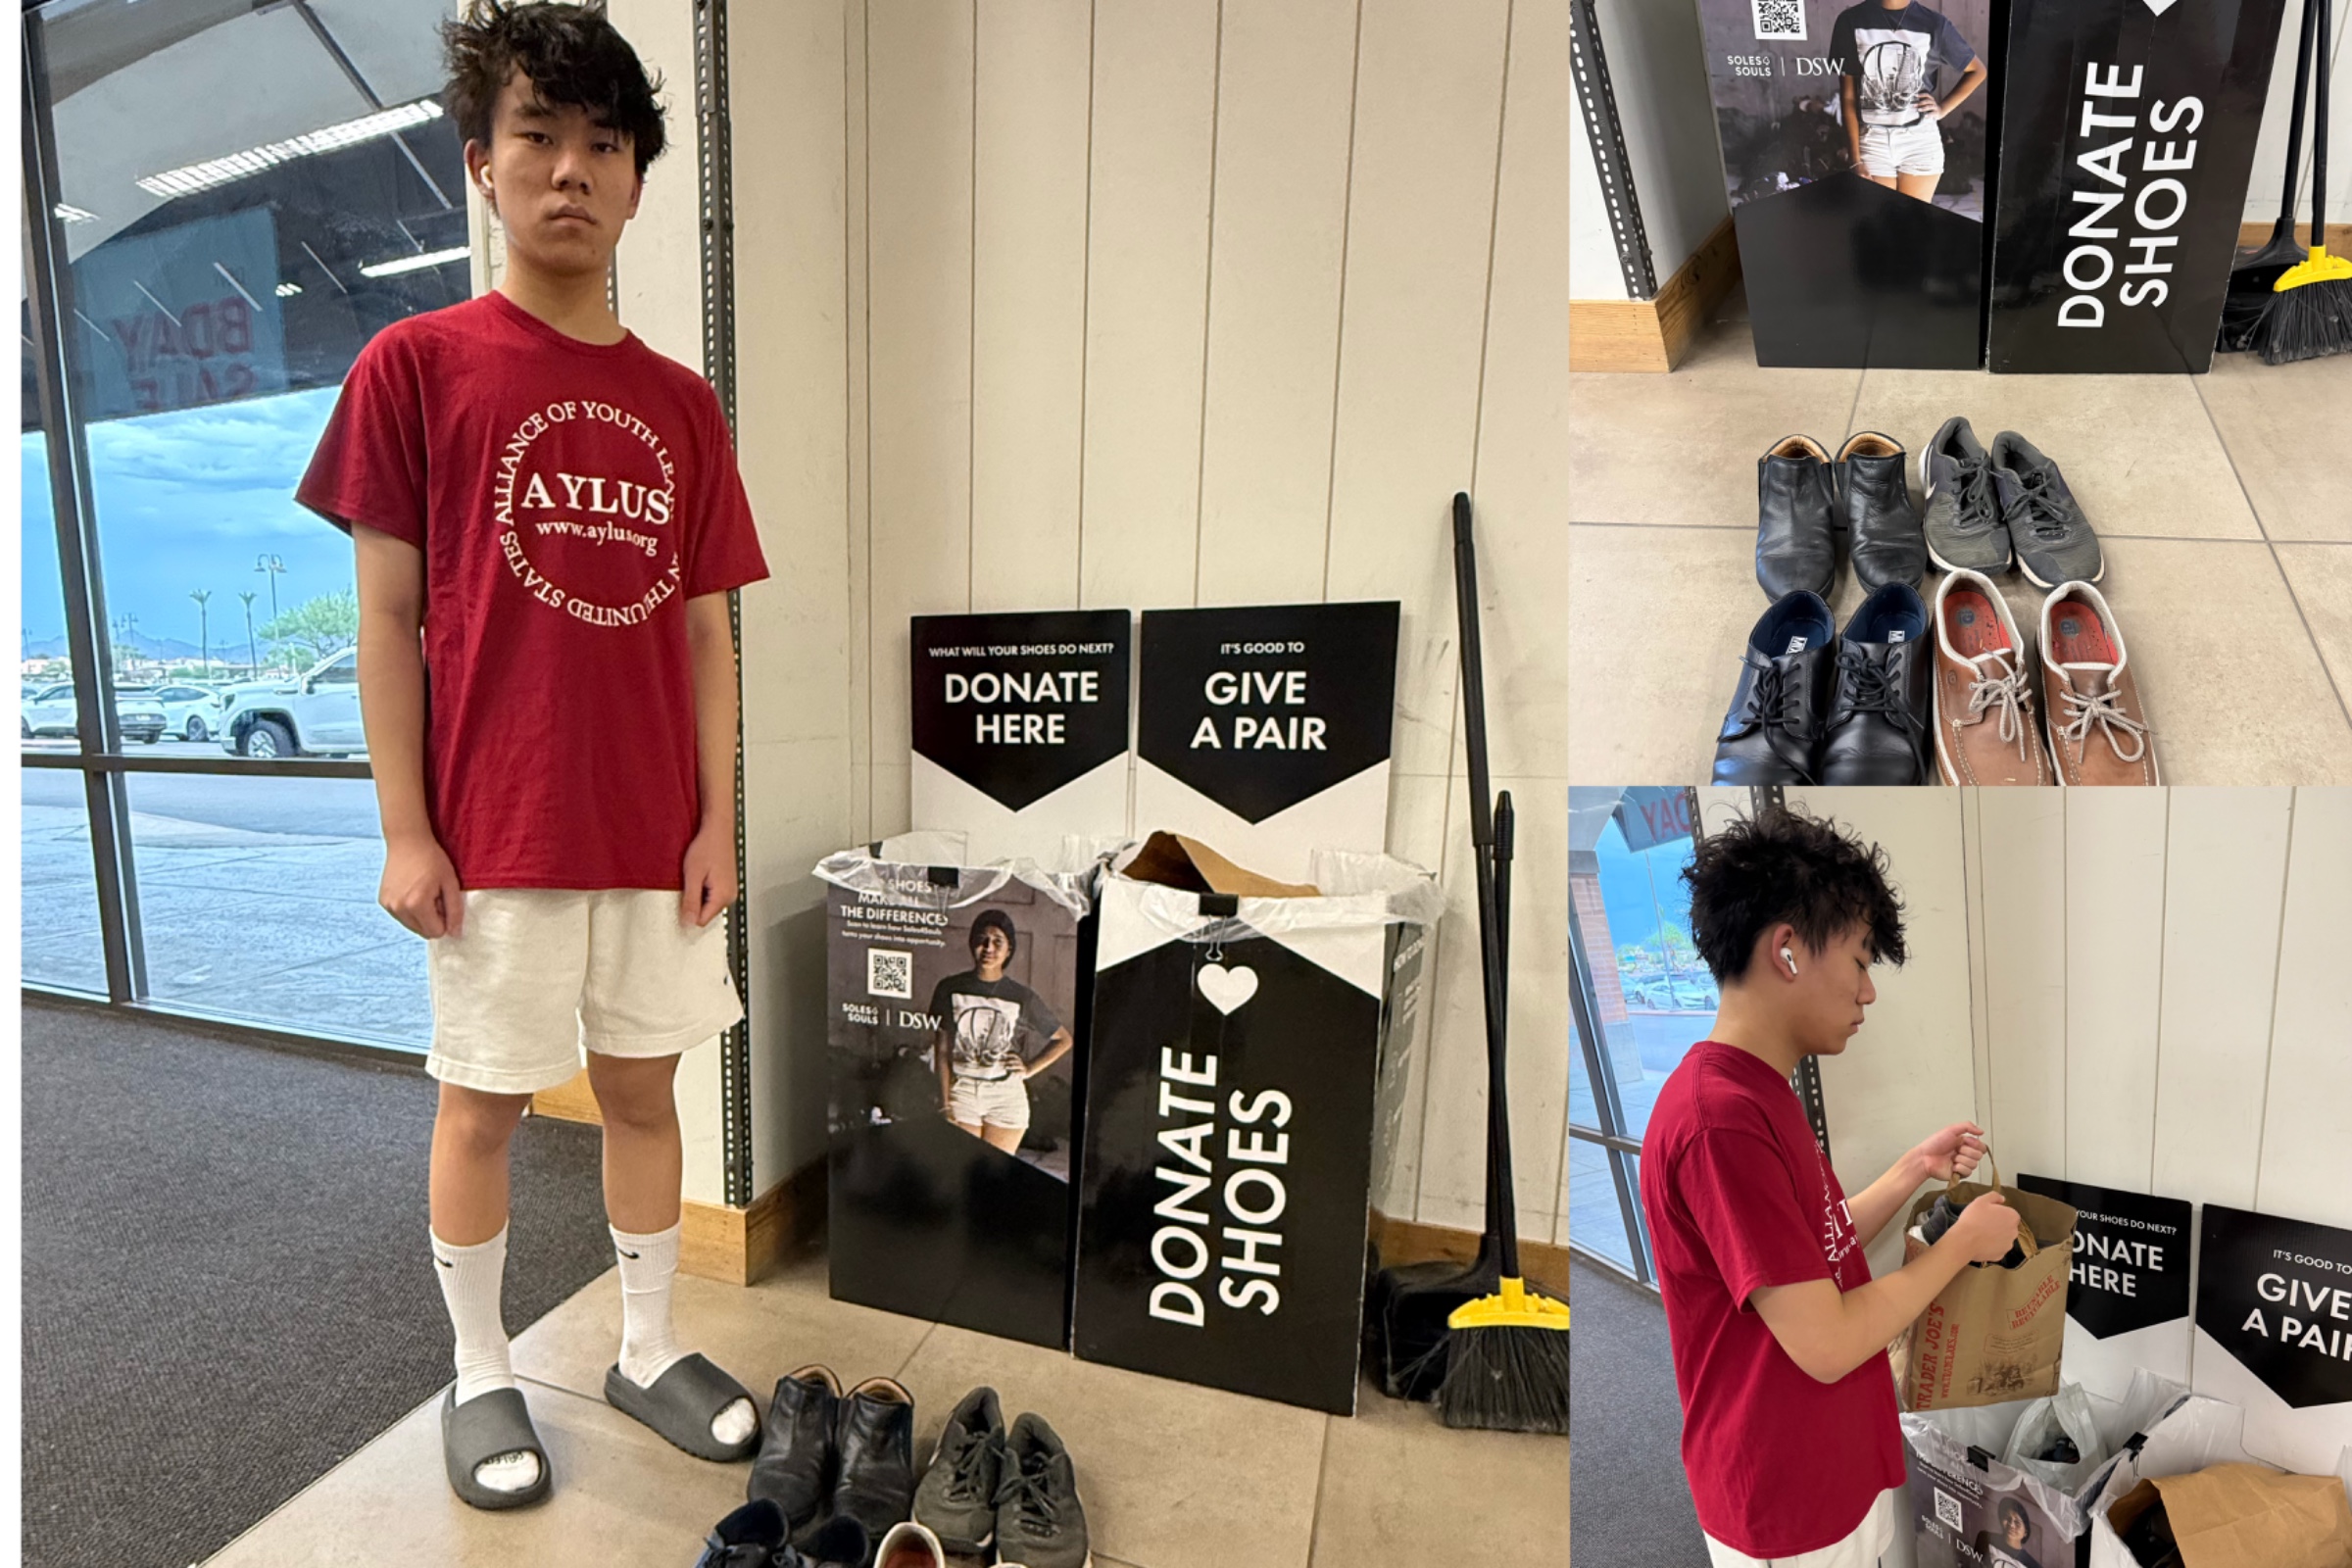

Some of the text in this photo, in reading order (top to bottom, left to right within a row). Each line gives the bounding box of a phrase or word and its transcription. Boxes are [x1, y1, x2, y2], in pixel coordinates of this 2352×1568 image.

[1735, 67, 1772, 77] SOULS
[1794, 57, 1845, 76] DSW
[2057, 61, 2144, 328] DONATE
[2119, 96, 2205, 308] SHOES
[546, 401, 577, 423] OF
[581, 400, 661, 451] YOUTH
[494, 413, 549, 526] ALLIANCE
[520, 472, 673, 526] AYLUS
[498, 530, 566, 609] STATES
[566, 597, 649, 627] UNITED
[929, 642, 1114, 658] WHAT WILL YOUR SHOES DO NEXT?
[1221, 641, 1305, 655] IT'S GOOD TO
[945, 671, 1099, 704] DONATE
[1204, 670, 1307, 706] GIVE
[976, 713, 1065, 744] HERE
[1190, 716, 1327, 751] A PAIR
[840, 905, 863, 918] THE
[858, 891, 890, 906] MAK
[848, 1012, 879, 1025] SOULS
[899, 1010, 943, 1031] DSW
[1149, 1046, 1217, 1327] DONATE
[1217, 1089, 1293, 1316] SHOES
[2099, 1214, 2129, 1227] SHOES
[2130, 1219, 2145, 1229] DO
[2146, 1222, 2178, 1236] NEXT?
[2072, 1230, 2164, 1272] ONATE
[2273, 1249, 2352, 1275] IT'S GOOD TO
[2068, 1261, 2137, 1298] HERE
[2257, 1273, 2352, 1321] GIVE
[2241, 1308, 2269, 1338] A
[1916, 1301, 1944, 1409] TRADER JOE'S
[1955, 1538, 1984, 1563] DSW
